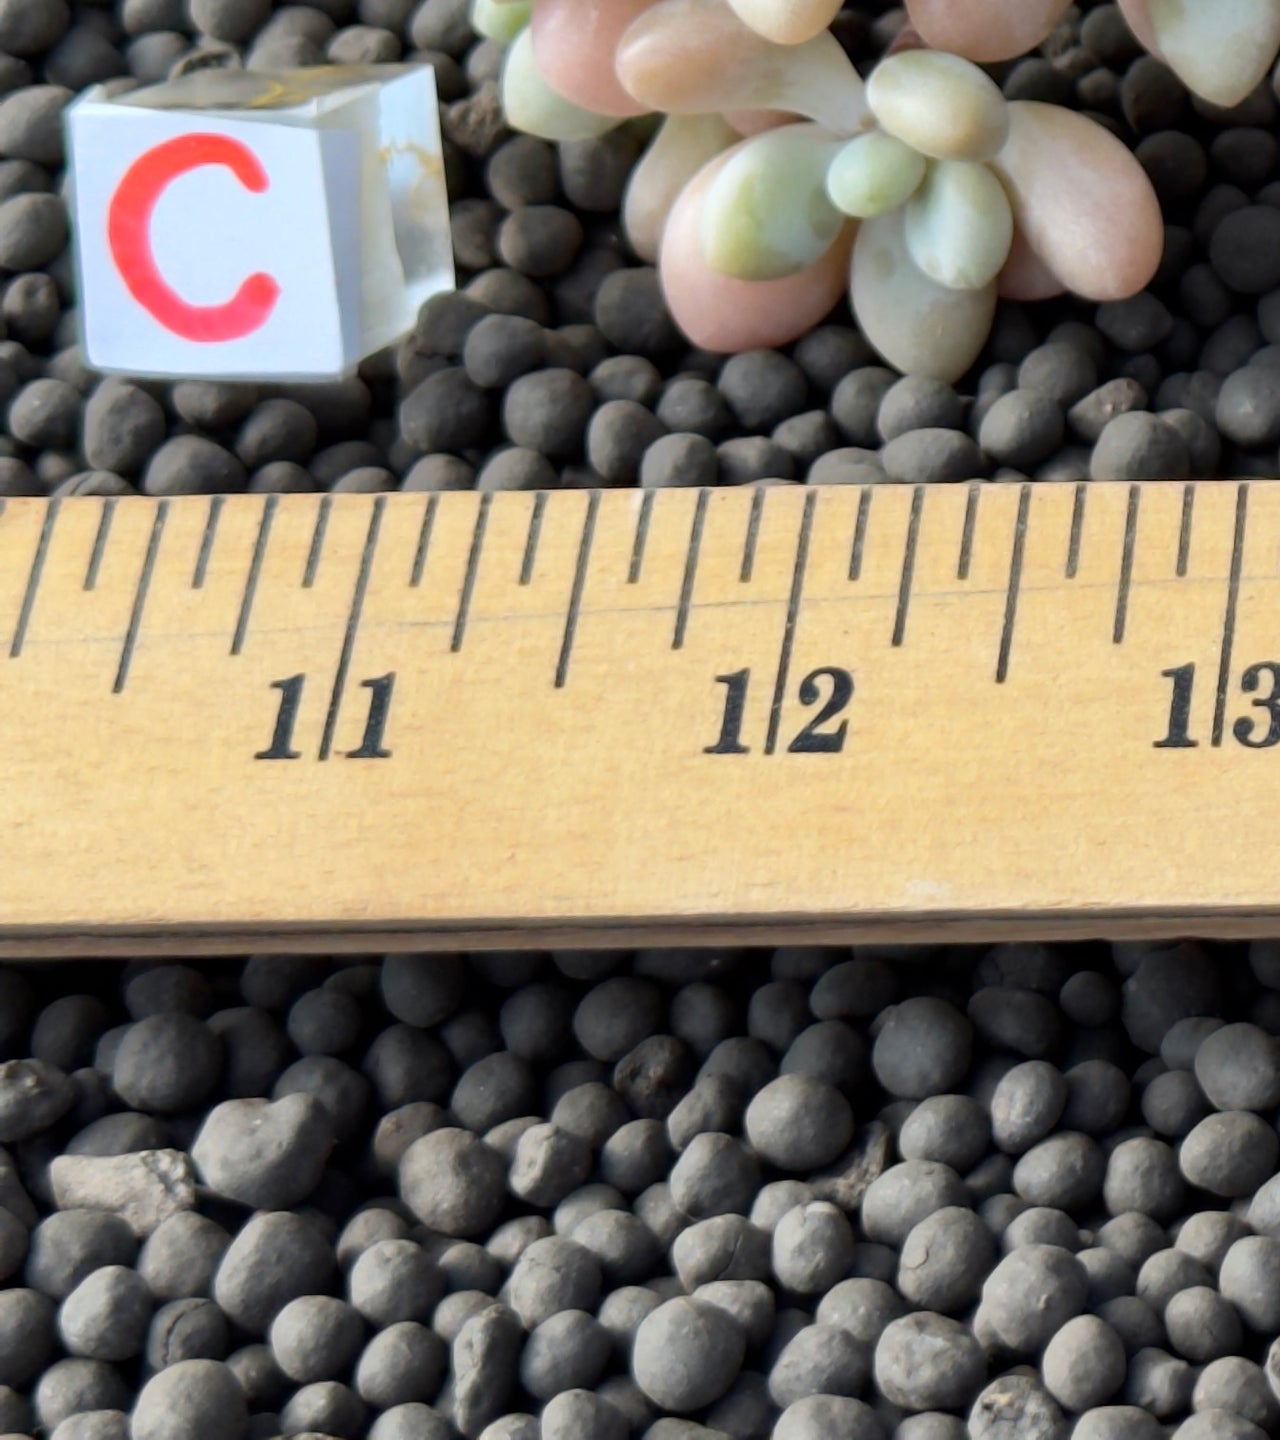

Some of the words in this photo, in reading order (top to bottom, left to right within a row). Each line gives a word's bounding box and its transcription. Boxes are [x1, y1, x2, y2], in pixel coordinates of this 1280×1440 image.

[107, 133, 277, 341] C
[254, 674, 394, 760] 11
[702, 667, 854, 755] 12
